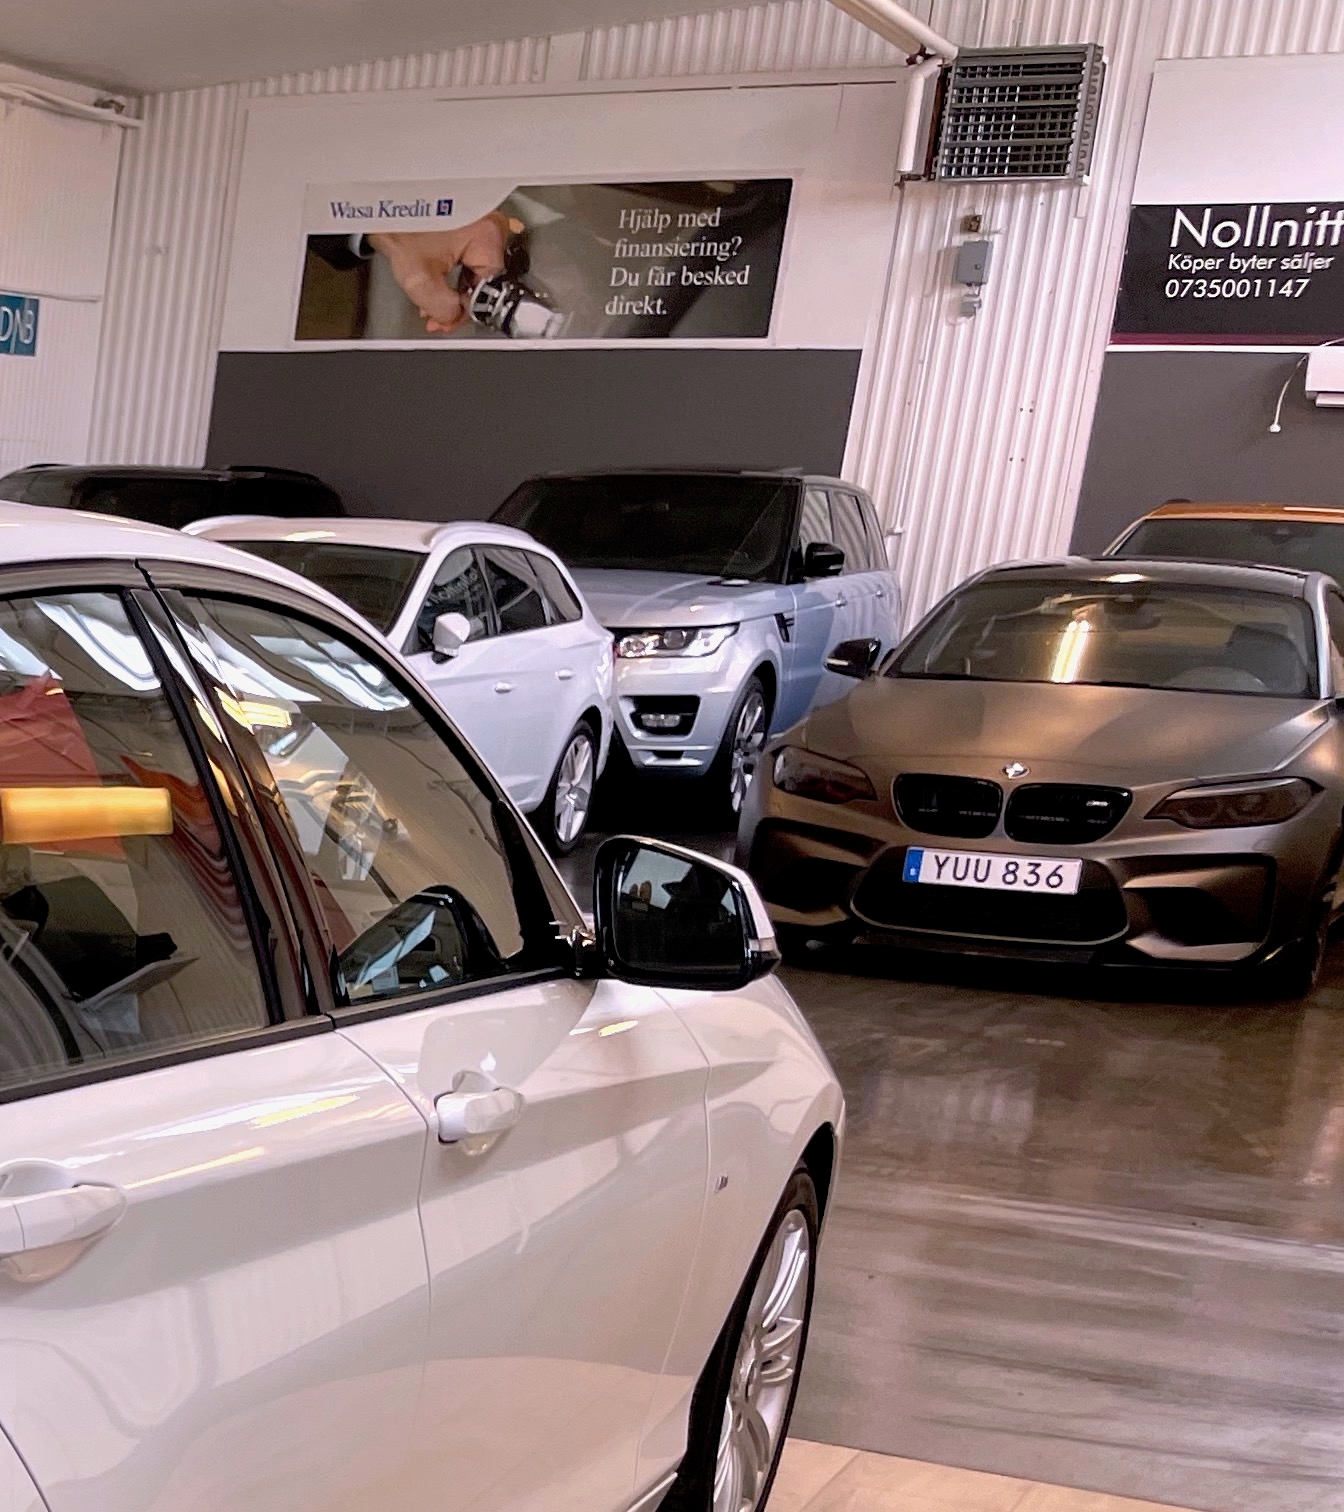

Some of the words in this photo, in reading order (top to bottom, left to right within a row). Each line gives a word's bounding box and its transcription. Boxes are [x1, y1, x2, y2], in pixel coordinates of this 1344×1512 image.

[330, 199, 373, 218] Wasa
[377, 198, 431, 218] Kredit
[618, 208, 671, 234] Hjälp
[677, 206, 722, 228] med
[1169, 205, 1344, 248] Nollnitt
[613, 235, 743, 262] finansiering?
[1168, 253, 1225, 274] Köper
[1228, 252, 1276, 273] byter
[1280, 251, 1335, 273] säljer
[609, 266, 639, 287] Du
[647, 265, 677, 287] får
[680, 264, 751, 286] besked
[1164, 278, 1311, 298] 0735001147
[604, 295, 667, 316] direkt.
[933, 855, 992, 883] YUU
[1001, 860, 1064, 889] 836
